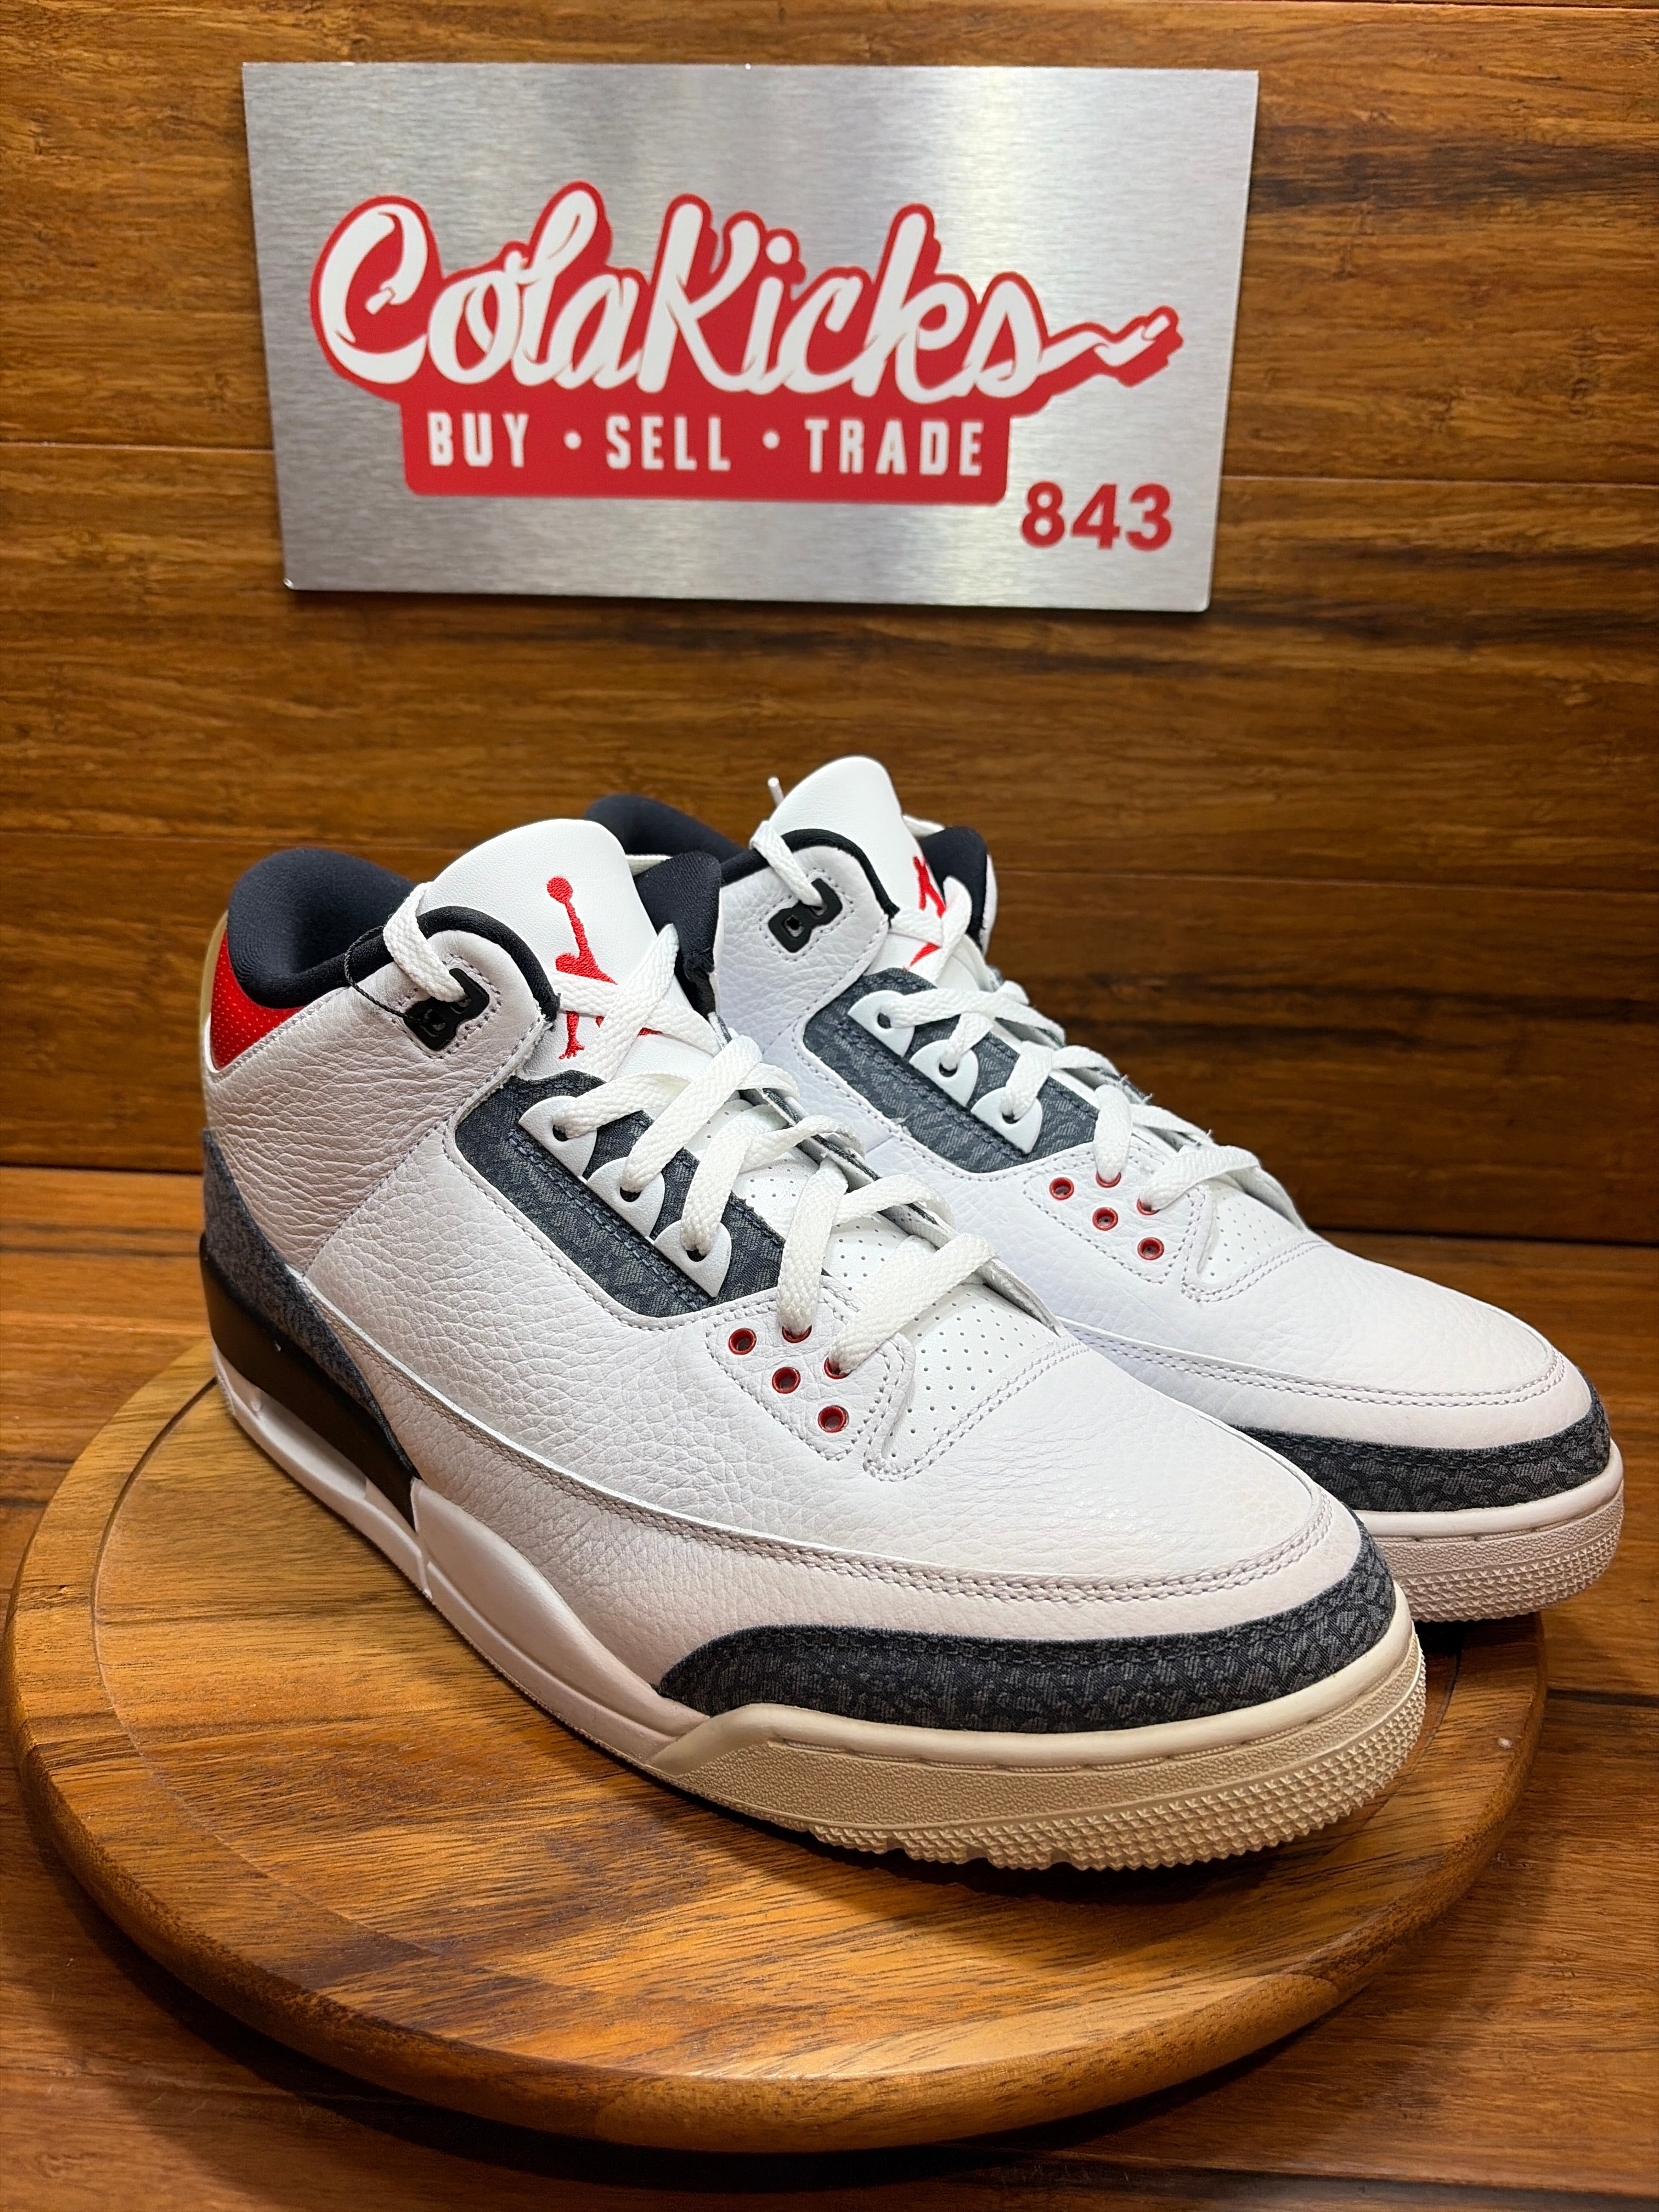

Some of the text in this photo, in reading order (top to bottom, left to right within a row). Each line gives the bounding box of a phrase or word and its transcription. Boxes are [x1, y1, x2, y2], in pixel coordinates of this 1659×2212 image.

[427, 410, 984, 477] BUY SELL TRADE
[1020, 481, 1173, 550] 843
